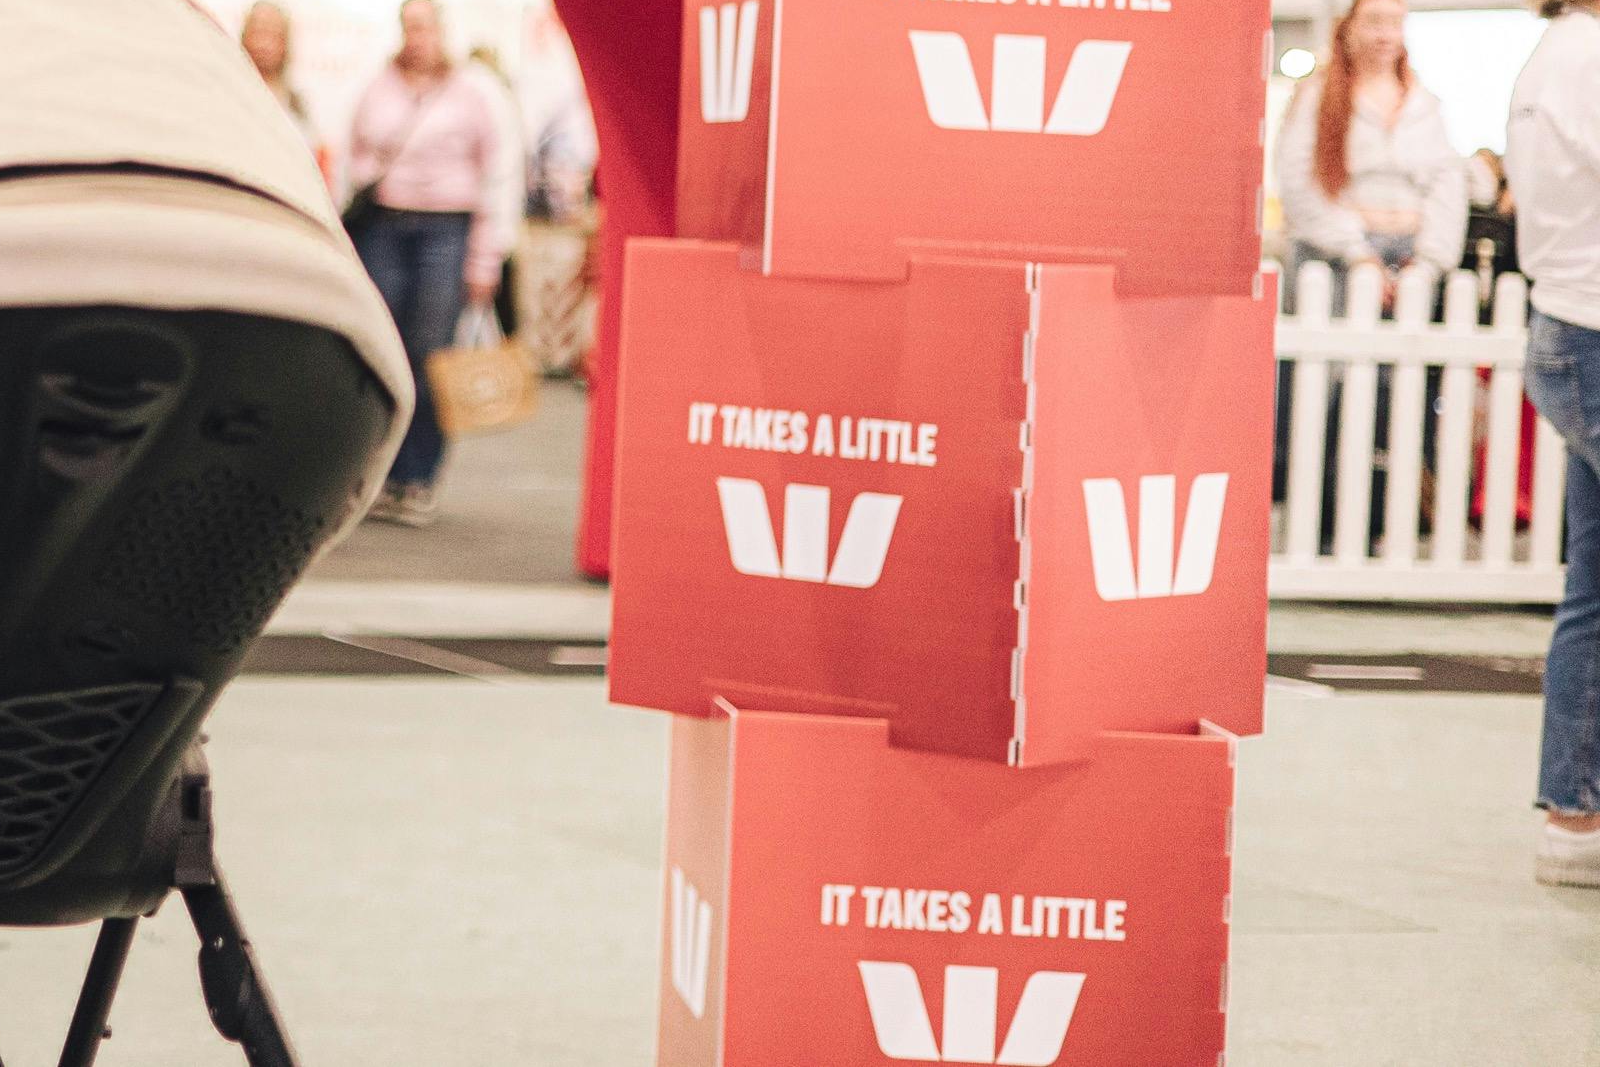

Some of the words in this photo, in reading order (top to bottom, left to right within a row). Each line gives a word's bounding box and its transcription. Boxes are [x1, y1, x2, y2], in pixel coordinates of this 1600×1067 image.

[687, 402, 717, 445] IT
[719, 405, 808, 455] TAKES
[812, 413, 834, 457] A
[839, 415, 939, 467] LITTLE
[820, 884, 856, 926] IT
[861, 886, 971, 933] TAKES
[978, 893, 1003, 935] A
[1011, 895, 1127, 941] LITTLE
